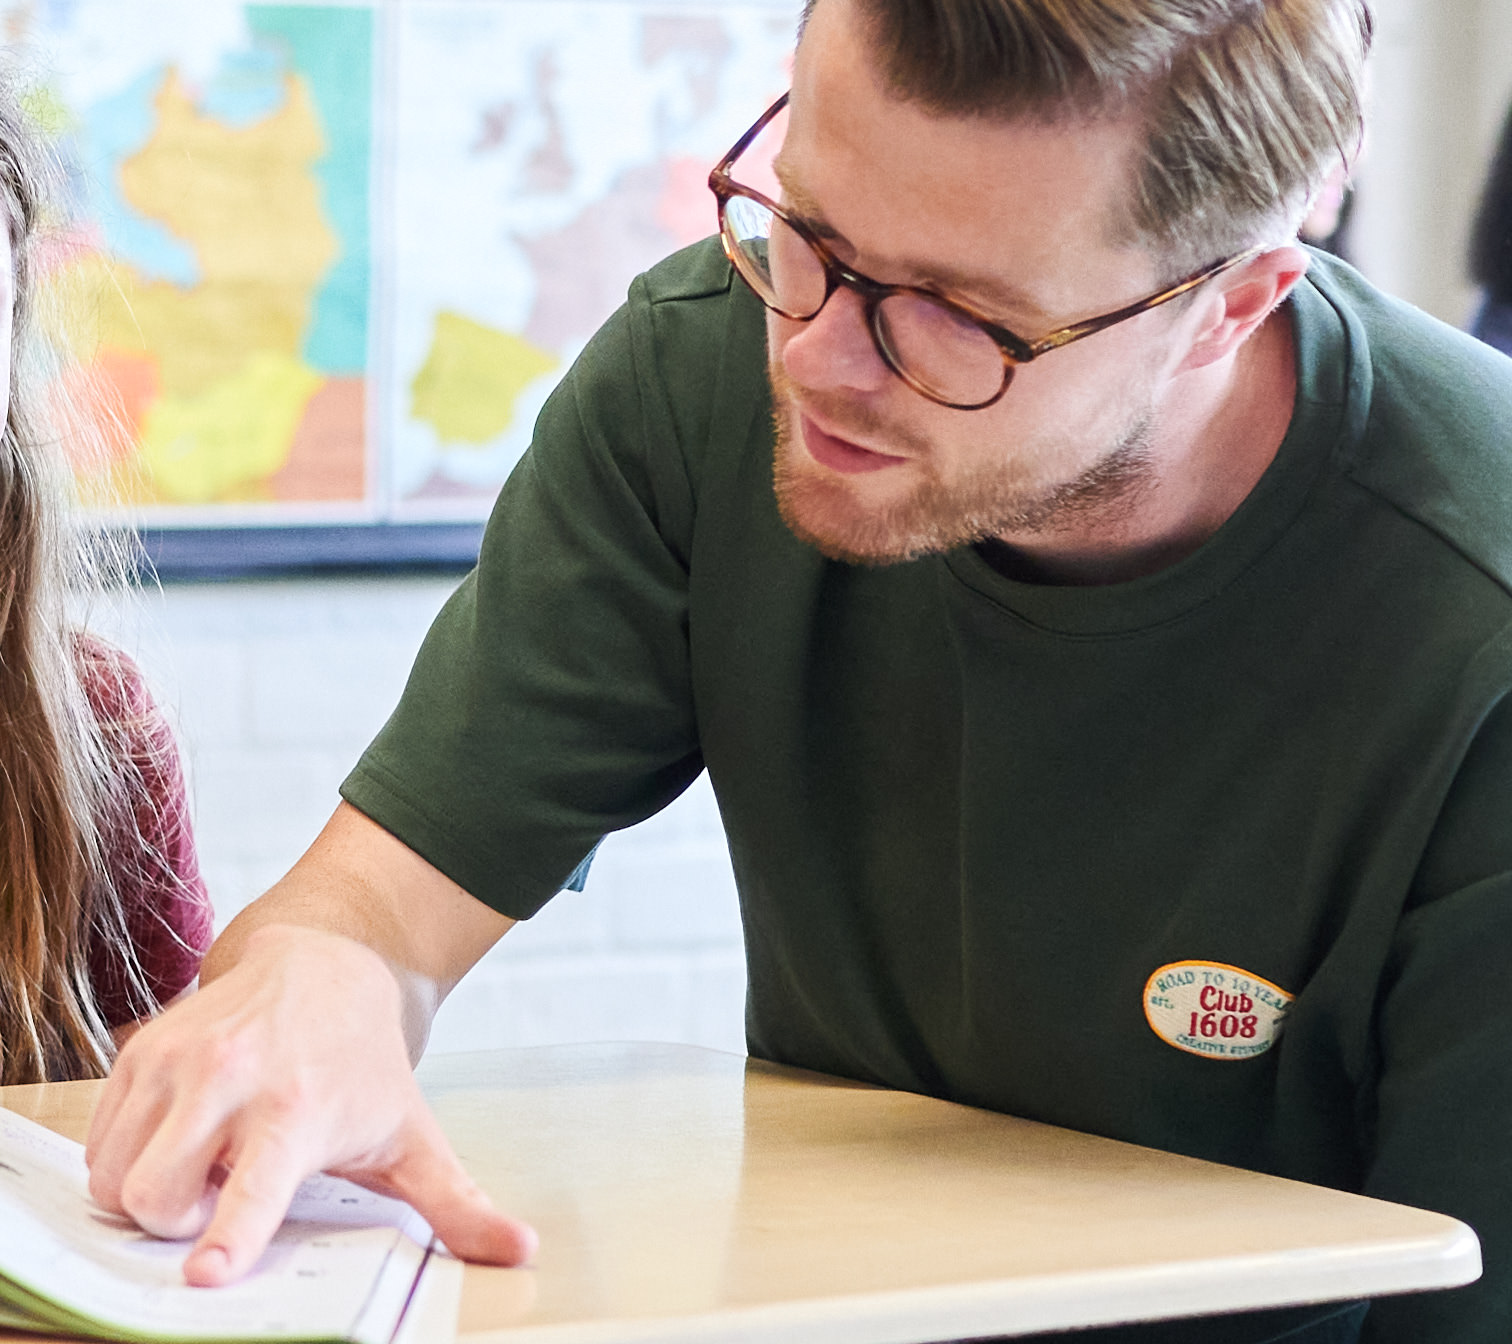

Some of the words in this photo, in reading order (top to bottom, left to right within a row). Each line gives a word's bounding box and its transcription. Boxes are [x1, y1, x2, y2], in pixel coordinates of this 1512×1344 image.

[1156, 971, 1195, 992] ROAD
[1203, 972, 1225, 985] TO
[1200, 985, 1254, 1013] Club
[1188, 1012, 1258, 1038] 1608
